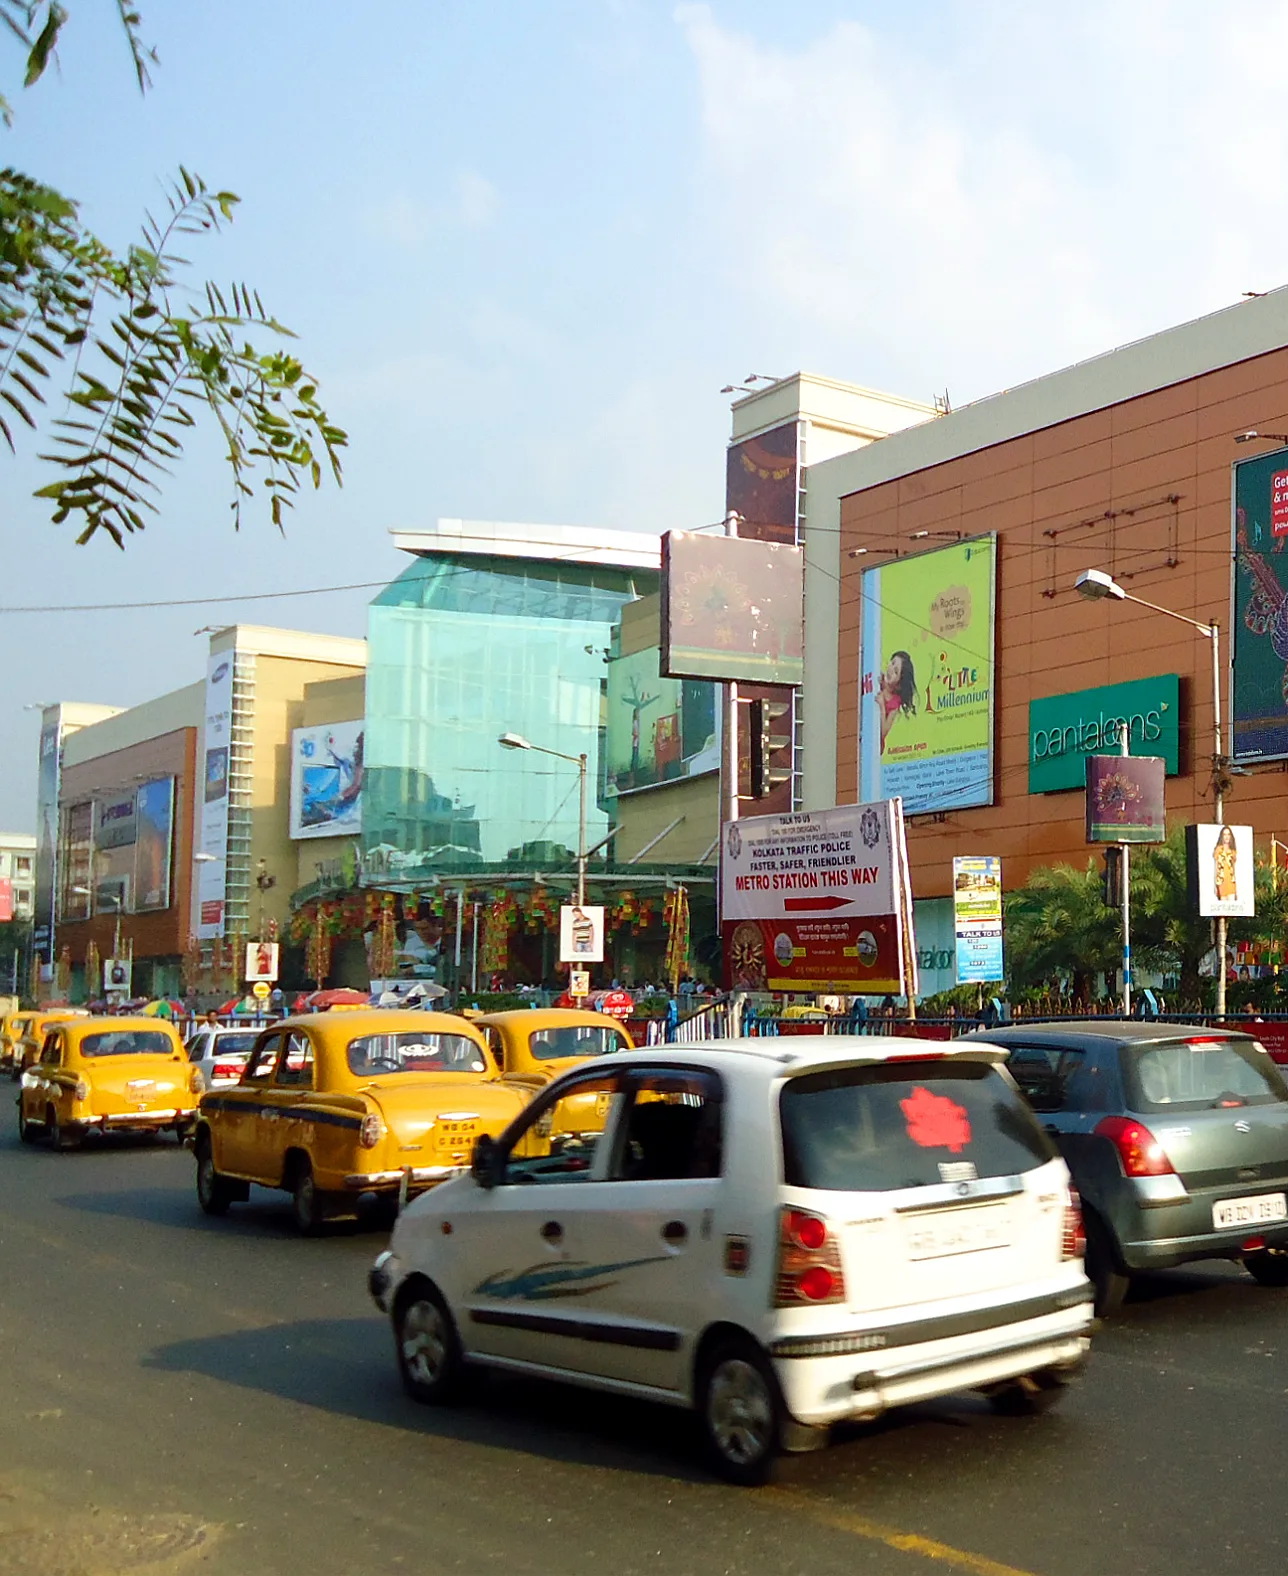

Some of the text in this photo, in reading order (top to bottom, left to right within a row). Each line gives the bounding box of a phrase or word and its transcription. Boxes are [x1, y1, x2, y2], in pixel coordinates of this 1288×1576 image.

[1273, 493, 1282, 503] &
[940, 596, 960, 609] Roots
[943, 608, 965, 620] Wings
[1033, 710, 1161, 762] pantaloons
[779, 814, 811, 825] TALK TO US
[752, 841, 851, 858] KOLKATA TRAFFIC POLICE
[750, 855, 857, 872] FASTER, SAFER, FRIENDLIER
[735, 866, 880, 891] METRO STATION THIS WAY
